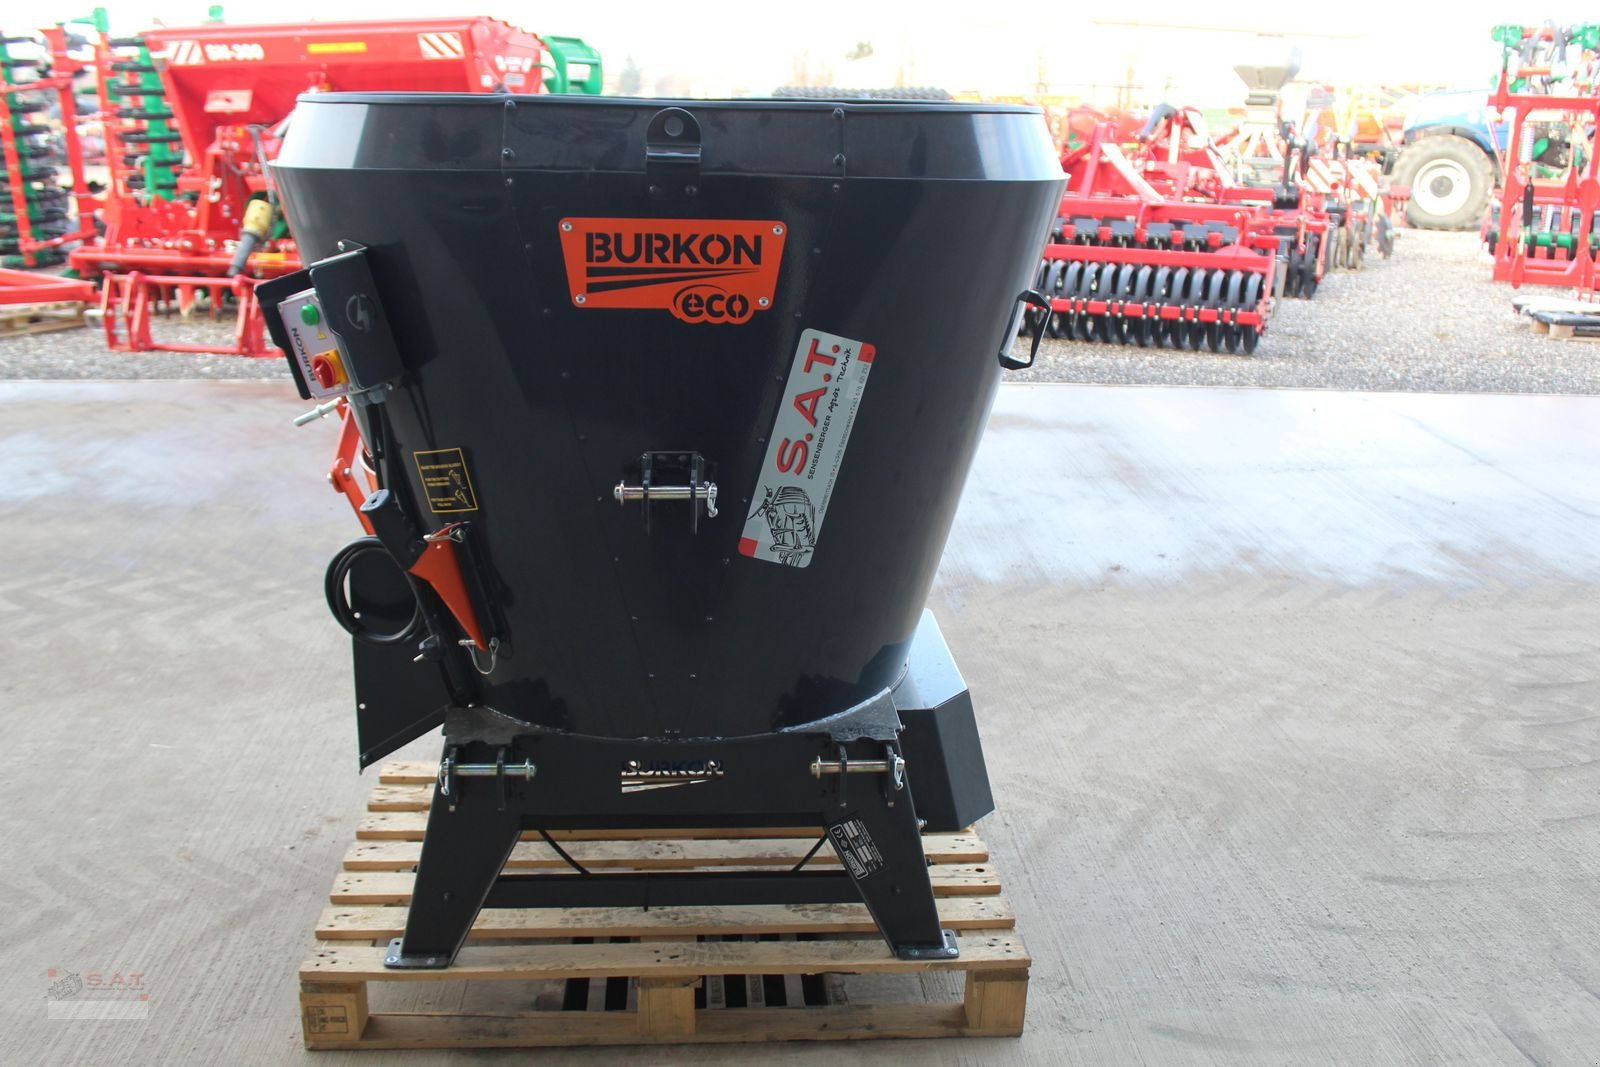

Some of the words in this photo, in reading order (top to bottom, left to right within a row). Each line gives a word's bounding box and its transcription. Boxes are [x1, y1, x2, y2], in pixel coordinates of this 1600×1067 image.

[586, 232, 762, 265] BURKON
[680, 291, 750, 319] eco
[291, 328, 316, 382] BURKON
[776, 338, 841, 476] S.A.T.
[806, 415, 832, 480] SENSENBERGER
